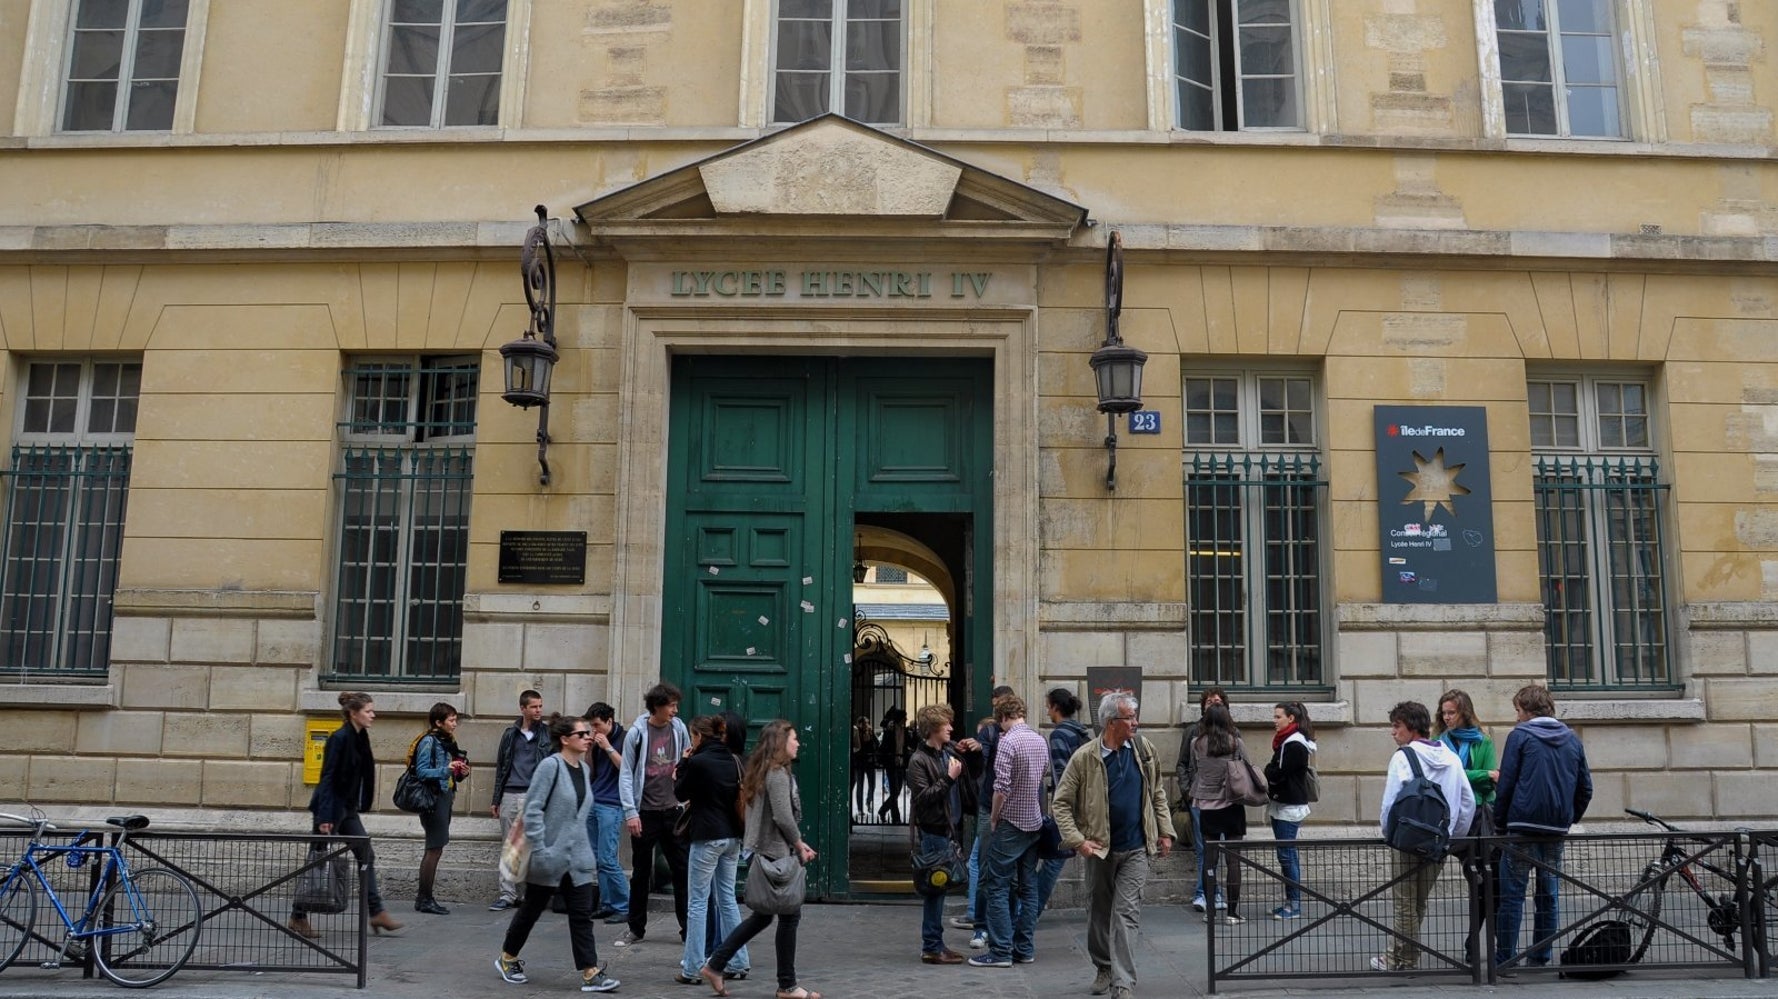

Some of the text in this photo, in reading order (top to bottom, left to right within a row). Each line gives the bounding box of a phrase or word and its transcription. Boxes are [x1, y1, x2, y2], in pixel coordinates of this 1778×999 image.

[671, 270, 993, 299] LYCEE HENRI IV
[1134, 413, 1156, 430] 23
